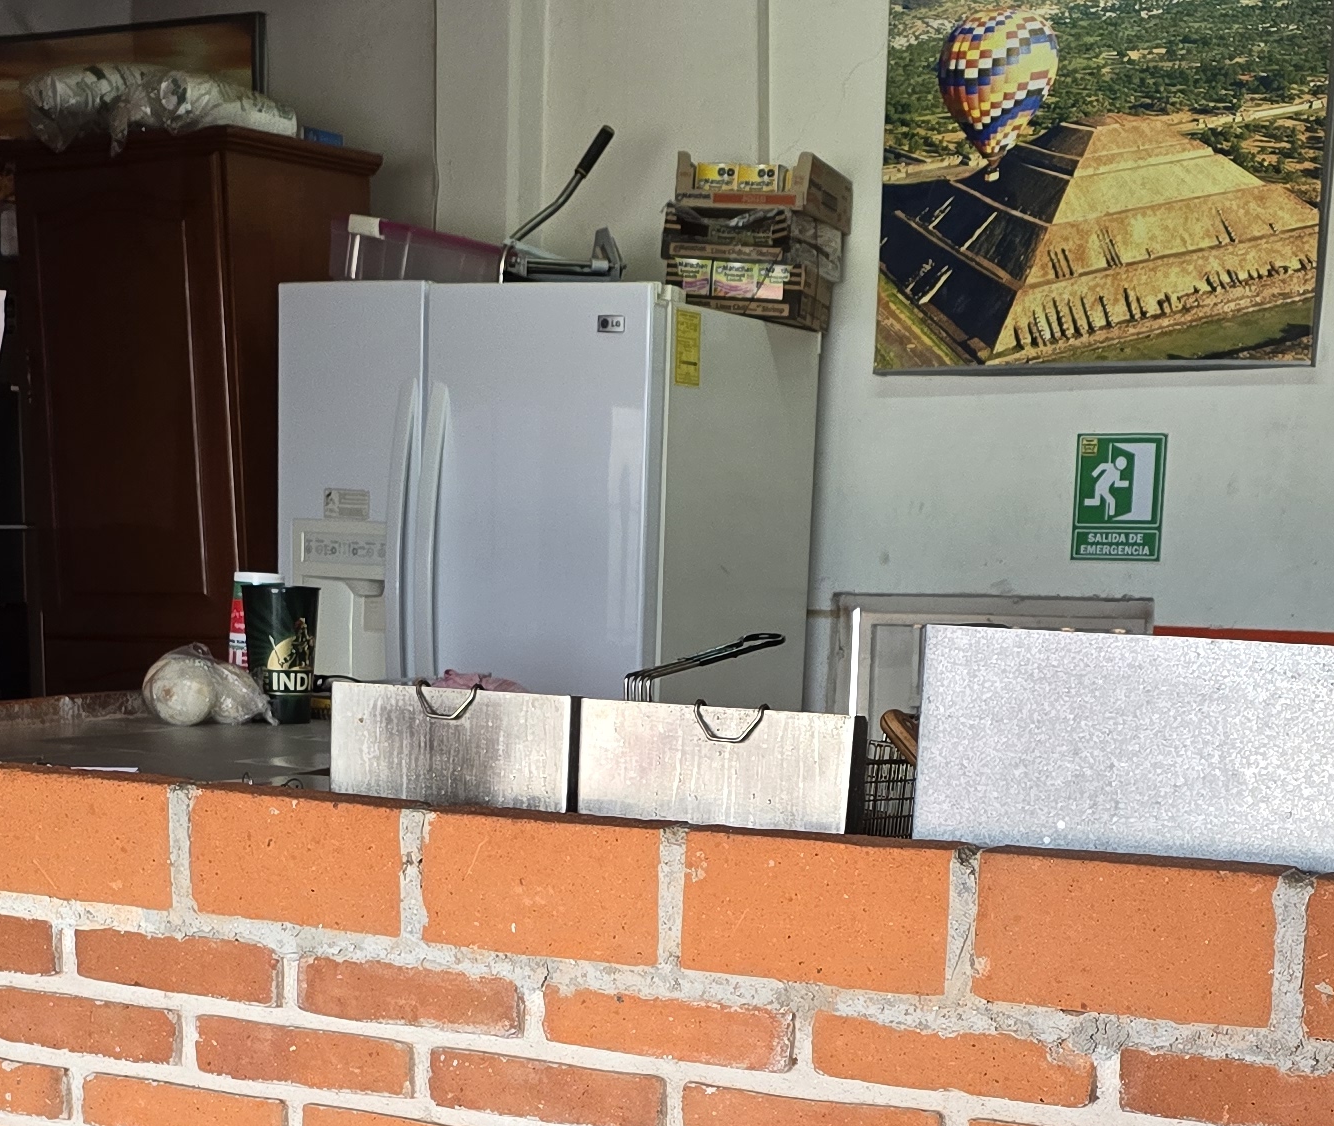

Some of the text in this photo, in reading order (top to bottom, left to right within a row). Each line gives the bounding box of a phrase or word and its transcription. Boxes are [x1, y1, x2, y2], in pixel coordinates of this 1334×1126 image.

[1087, 533, 1144, 543] SALIDA DE
[1080, 544, 1150, 555] EMERGENCIA
